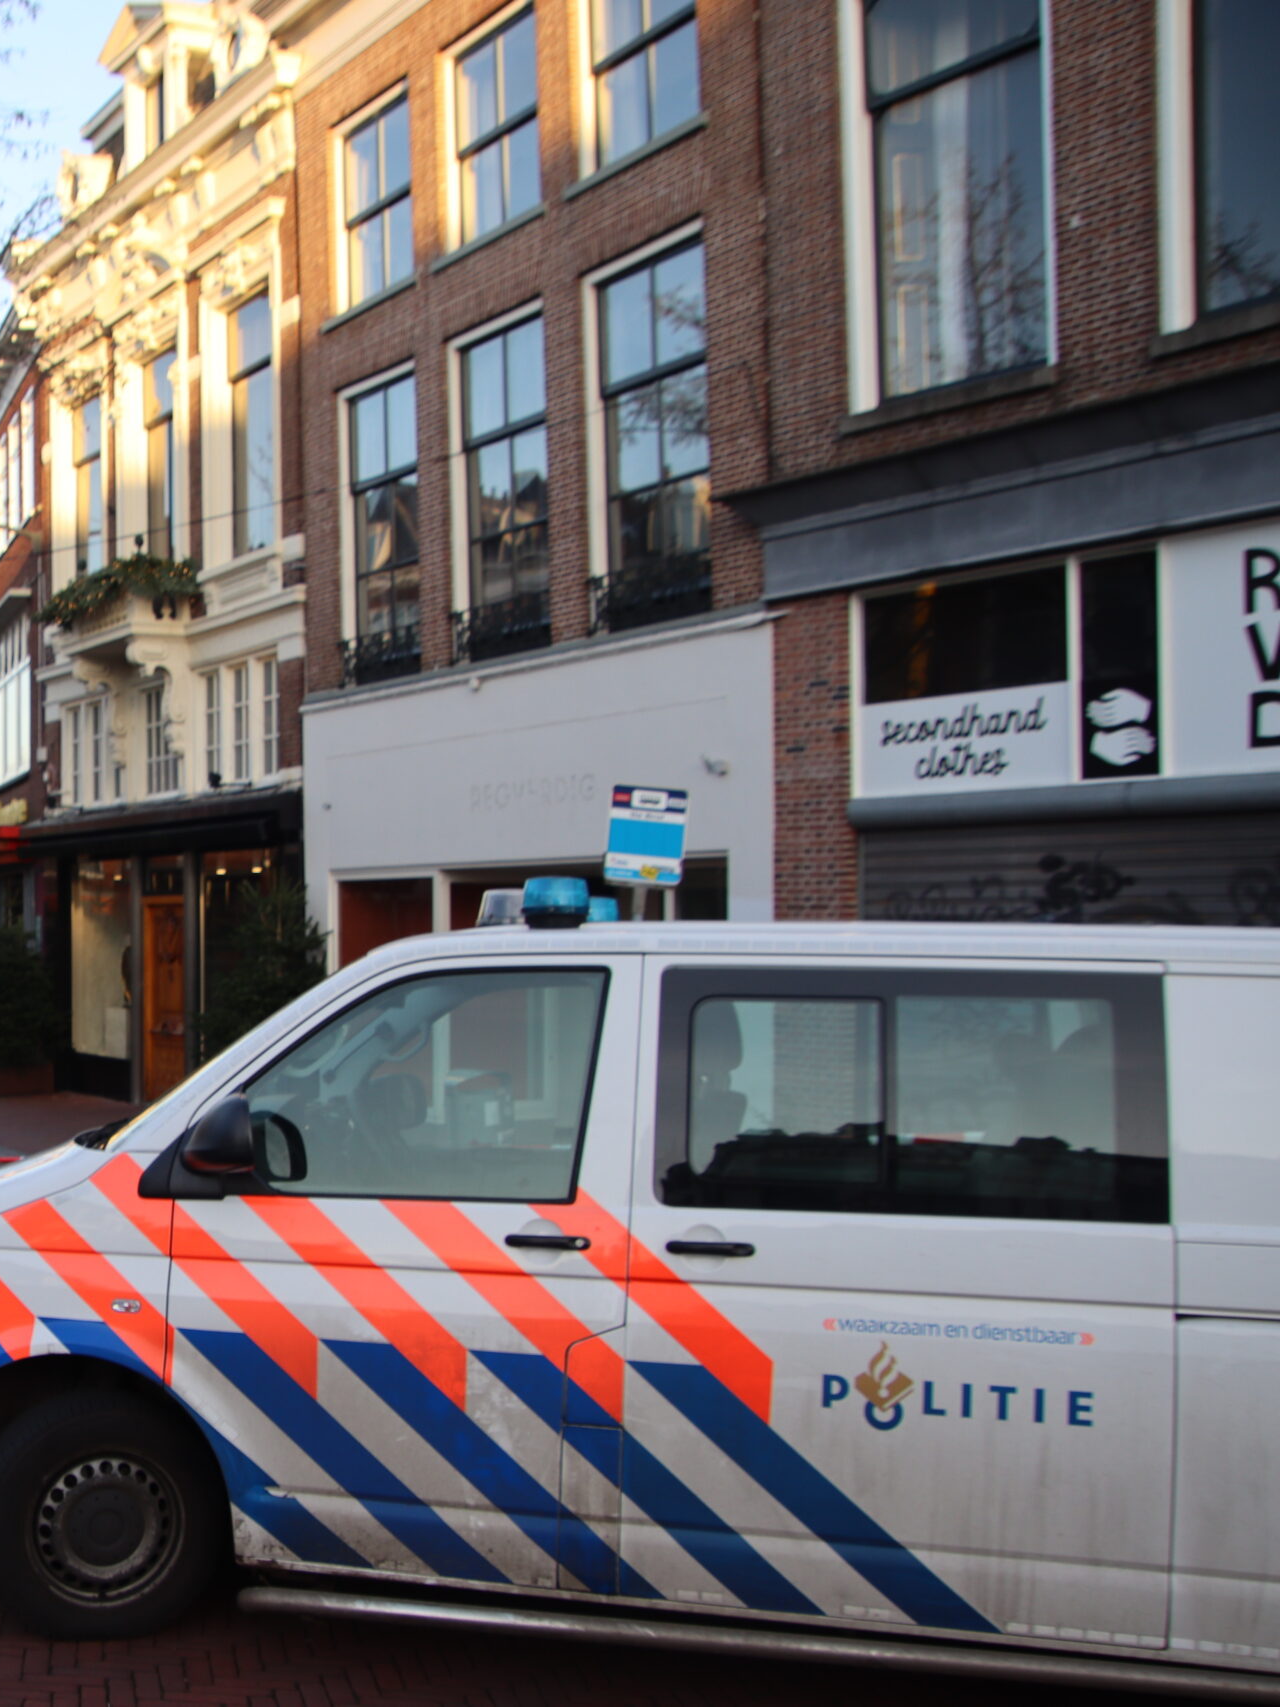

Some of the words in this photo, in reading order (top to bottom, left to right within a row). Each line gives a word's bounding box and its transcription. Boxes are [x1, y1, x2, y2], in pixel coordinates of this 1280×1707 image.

[880, 695, 1048, 747] secondhand
[914, 742, 1010, 780] clothes
[837, 1317, 941, 1338] waakzaam
[943, 1320, 969, 1339] en
[971, 1322, 1078, 1346] dienstbaar
[821, 1373, 1095, 1431] POLITIE
